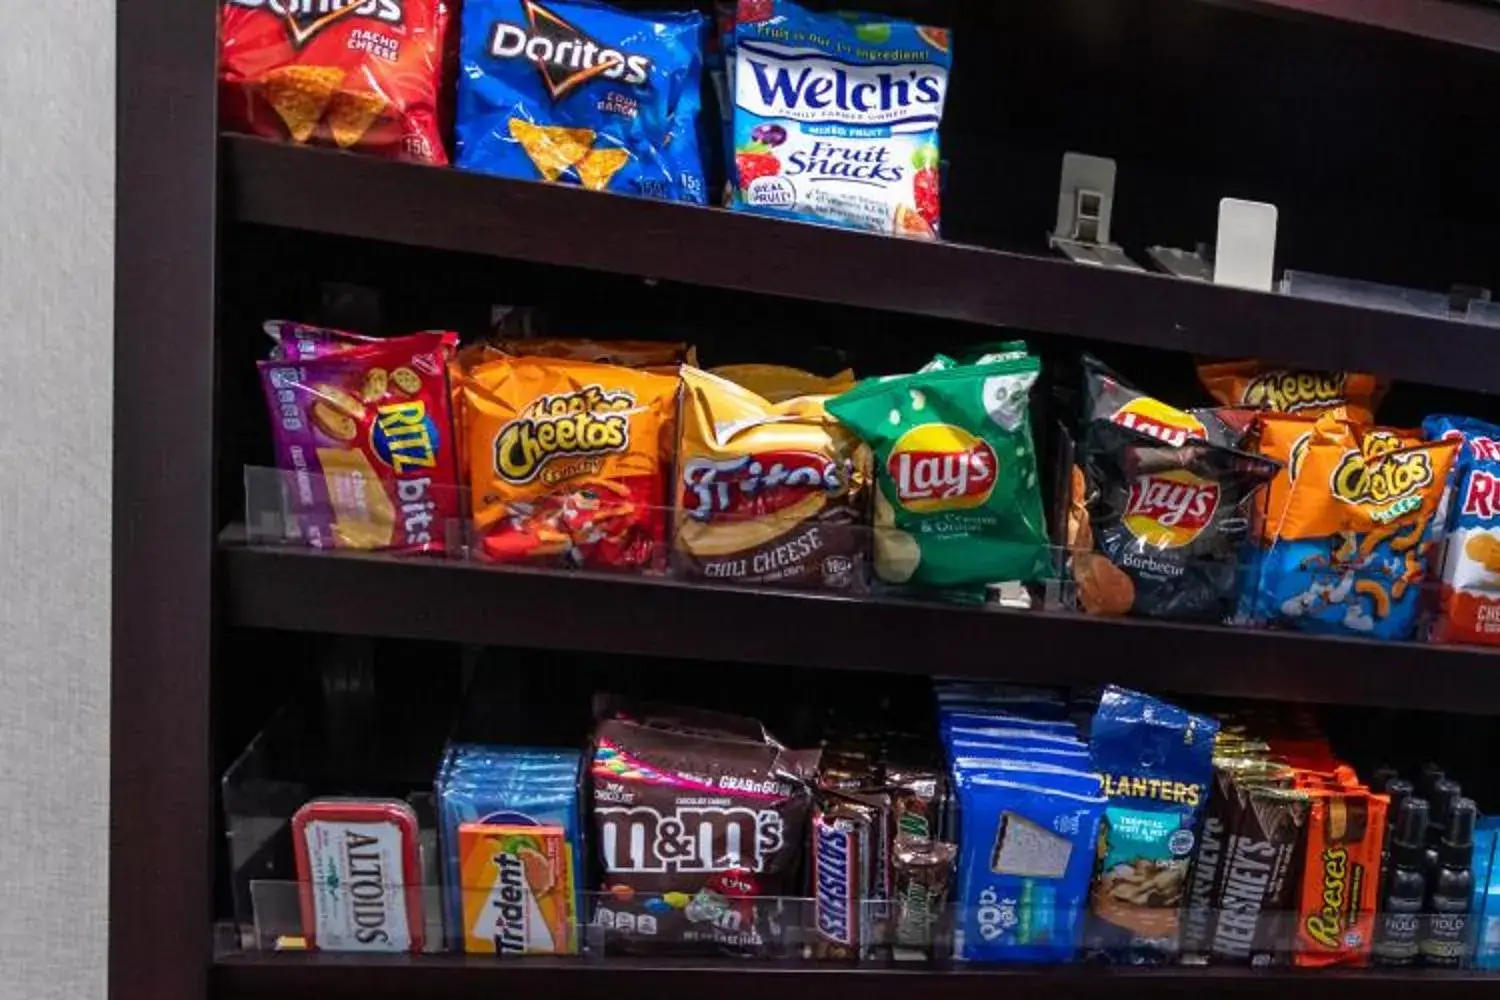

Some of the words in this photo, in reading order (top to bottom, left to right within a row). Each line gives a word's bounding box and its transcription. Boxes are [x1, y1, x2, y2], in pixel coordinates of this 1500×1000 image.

[490, 22, 650, 84] Doritos
[746, 57, 940, 112] Welch's
[785, 151, 904, 182] Snacks
[811, 142, 891, 163] Fruit
[378, 400, 437, 474] RITZ
[498, 414, 627, 480] Cheetos
[899, 449, 990, 498] Lay's
[1131, 477, 1215, 527] Lay's
[397, 477, 435, 545] bits
[705, 559, 746, 577] CHILI
[753, 528, 823, 573] CHEESE
[1099, 773, 1200, 806] LANTERS
[344, 829, 389, 945] ALTOIDS
[493, 853, 524, 959] Trident
[1214, 836, 1277, 956] HERSHEY'S
[1307, 847, 1349, 949] Reese's
